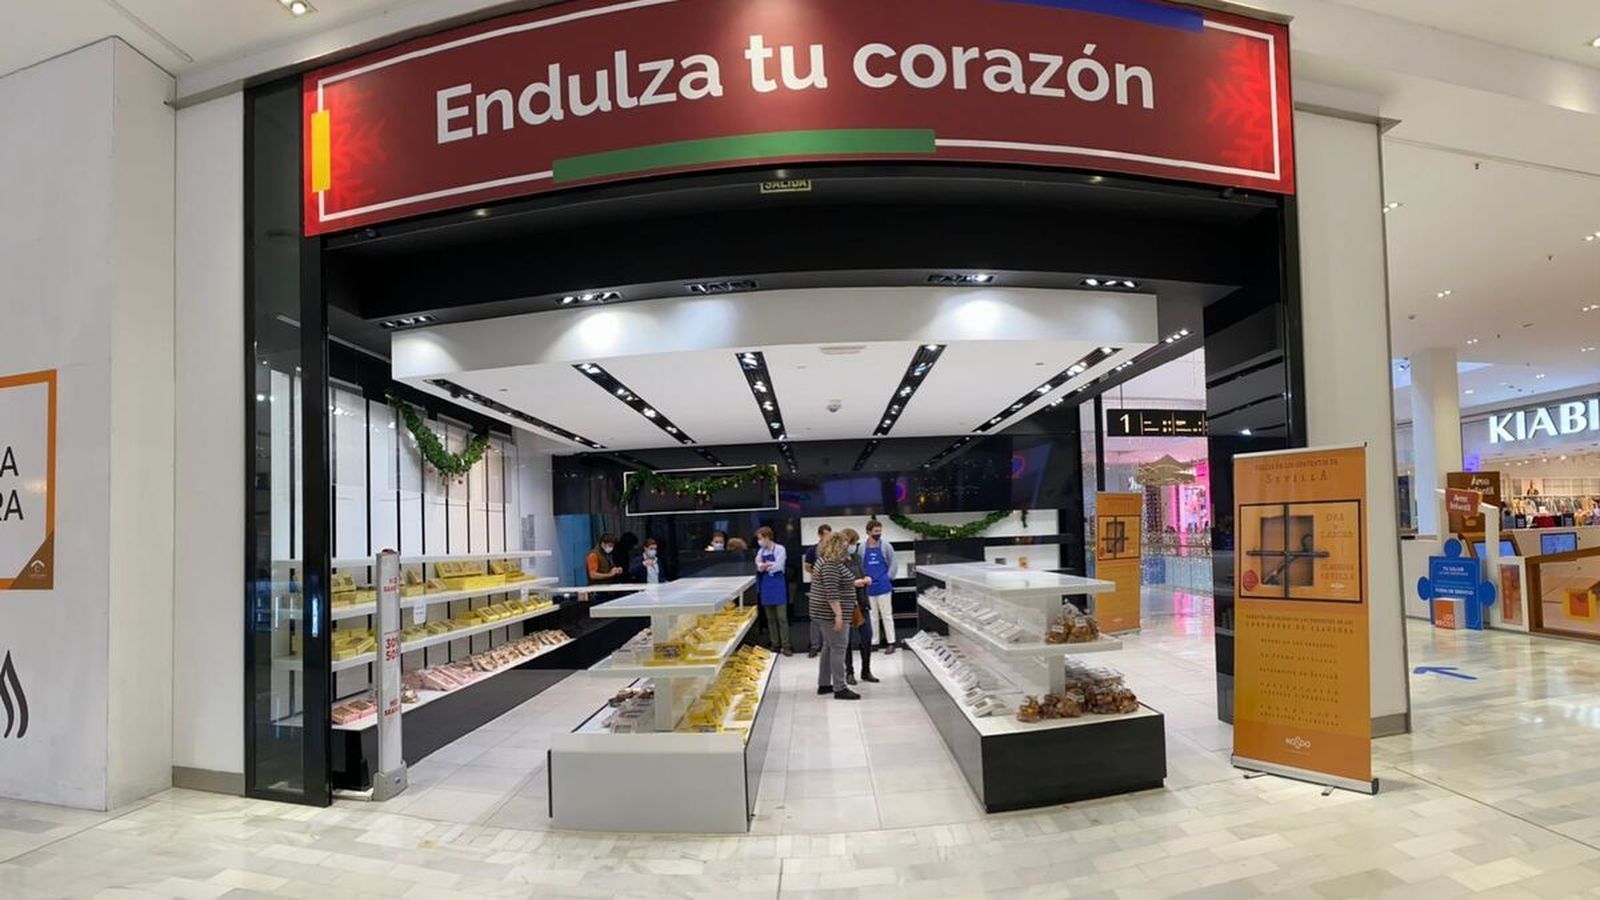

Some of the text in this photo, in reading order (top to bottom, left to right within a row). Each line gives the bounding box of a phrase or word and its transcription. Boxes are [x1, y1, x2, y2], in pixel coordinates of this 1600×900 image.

[437, 34, 1154, 144] Endulza tu corazón
[1120, 414, 1130, 433] 1
[1489, 398, 1600, 444] KIABI
[0, 490, 24, 521] A
